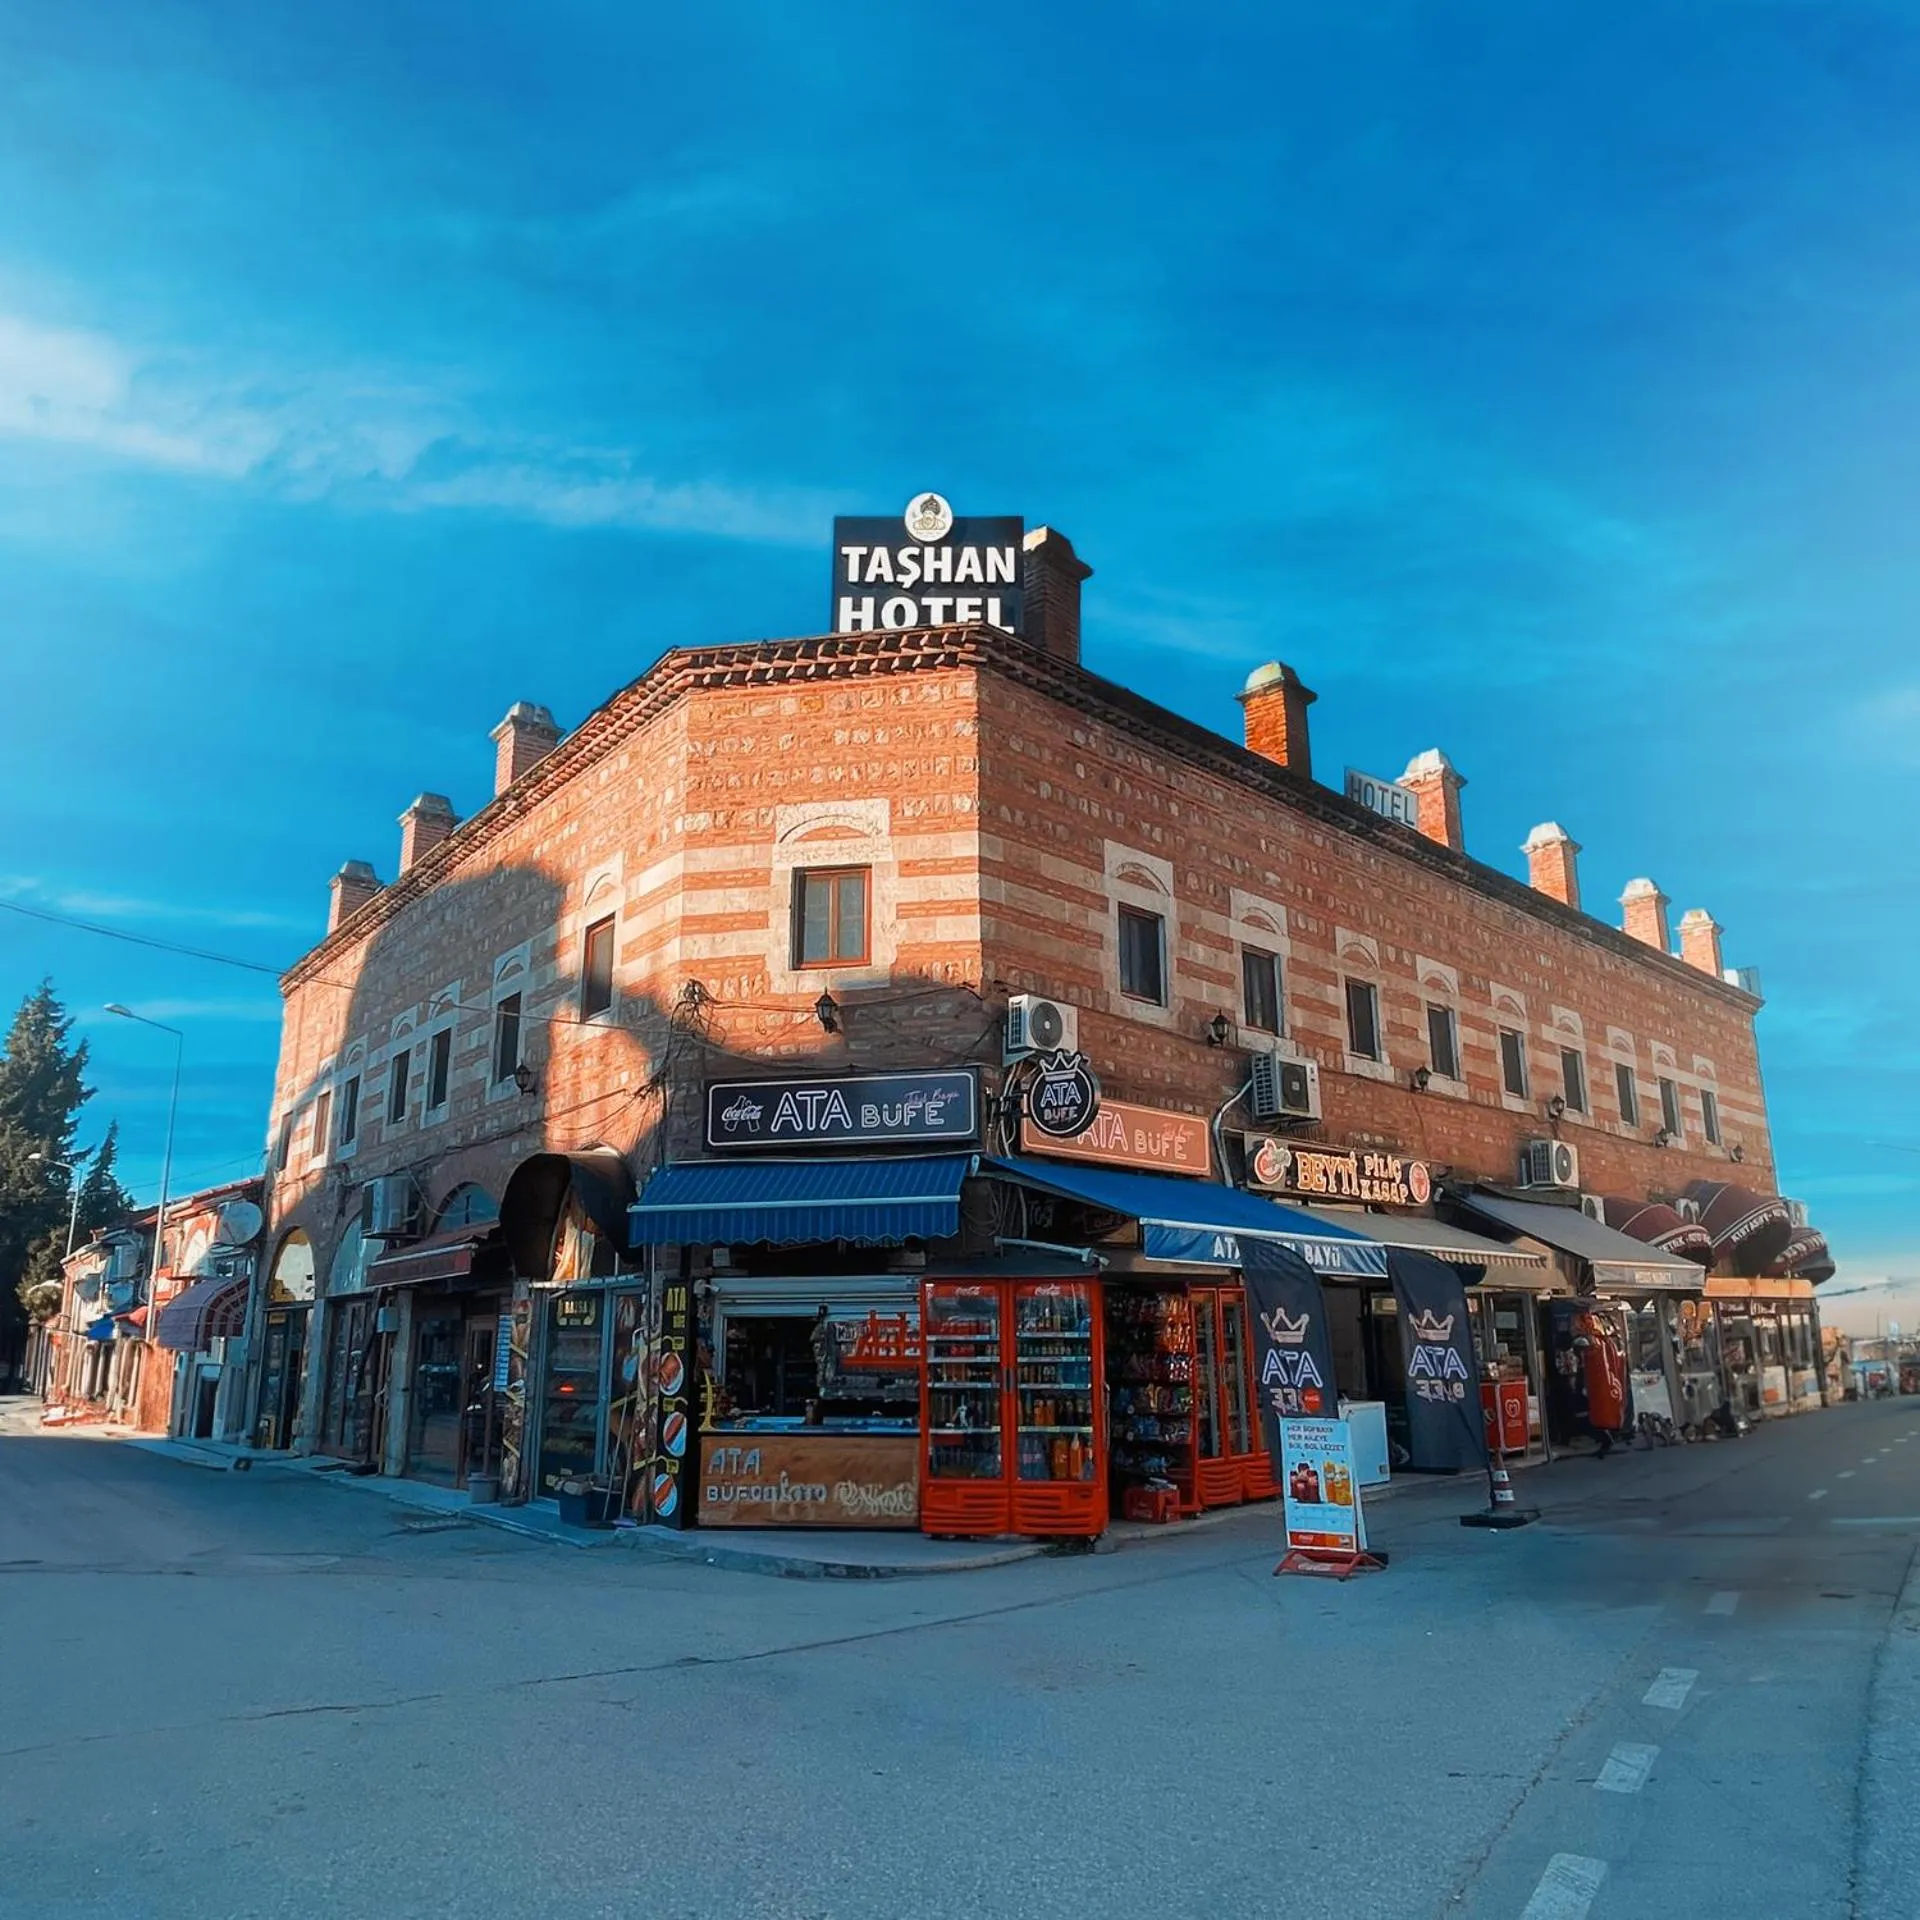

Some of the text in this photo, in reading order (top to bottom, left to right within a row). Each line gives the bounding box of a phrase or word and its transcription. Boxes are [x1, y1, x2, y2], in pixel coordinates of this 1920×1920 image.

[841, 546, 1016, 589] TAŞHAN
[839, 597, 1015, 634] HOTEL
[1350, 773, 1415, 826] HOTEL
[771, 1090, 852, 1133] ATA
[861, 1102, 945, 1129] BÜFE
[1040, 1081, 1082, 1108] ATA
[1134, 1129, 1188, 1161] BÜFE
[1295, 1151, 1361, 1196] BEYTİ
[1360, 1179, 1409, 1203] KASAP
[666, 1287, 686, 1312] ATA
[707, 1447, 761, 1475] ATA
